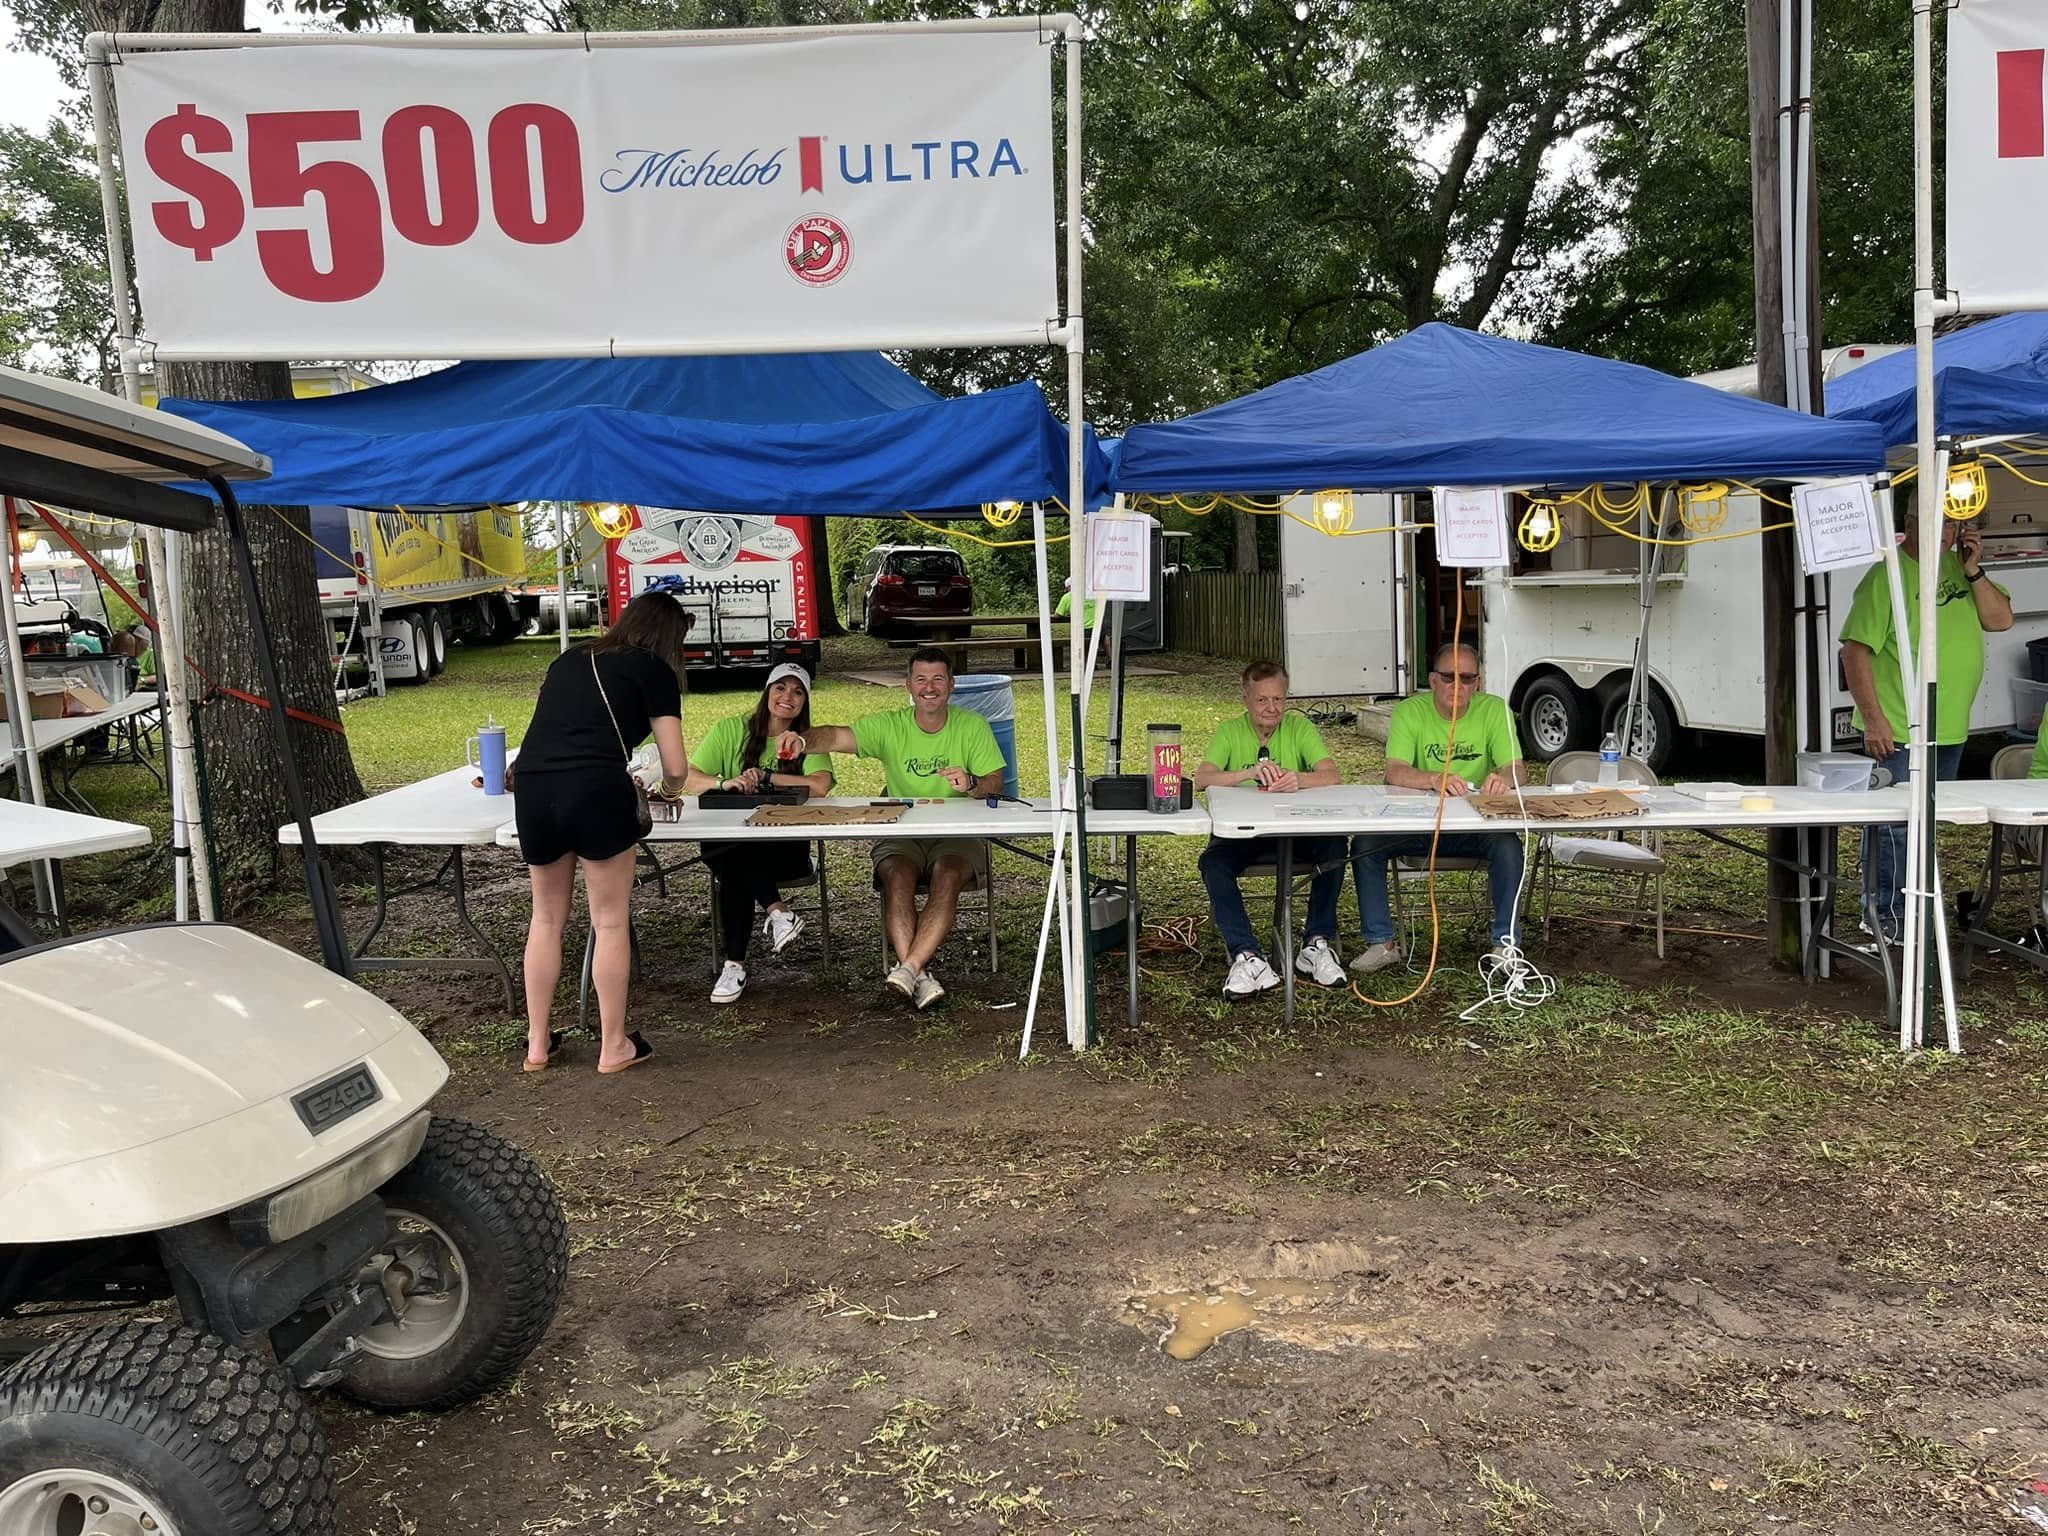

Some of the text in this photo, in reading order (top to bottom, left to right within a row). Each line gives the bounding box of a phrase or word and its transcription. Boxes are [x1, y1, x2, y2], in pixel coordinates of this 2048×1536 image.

[600, 138, 1023, 193] Michelob ULTRA
[144, 103, 585, 303] $500
[787, 219, 831, 250] DEL PAPA
[1811, 511, 1866, 527] CREDIT CARDS
[1818, 501, 1854, 515] MAJOR
[1820, 523, 1859, 536] ACCEPTED
[643, 574, 781, 596] Bdweiser
[795, 561, 808, 641] GENUINE
[1158, 747, 1180, 769] TIPS
